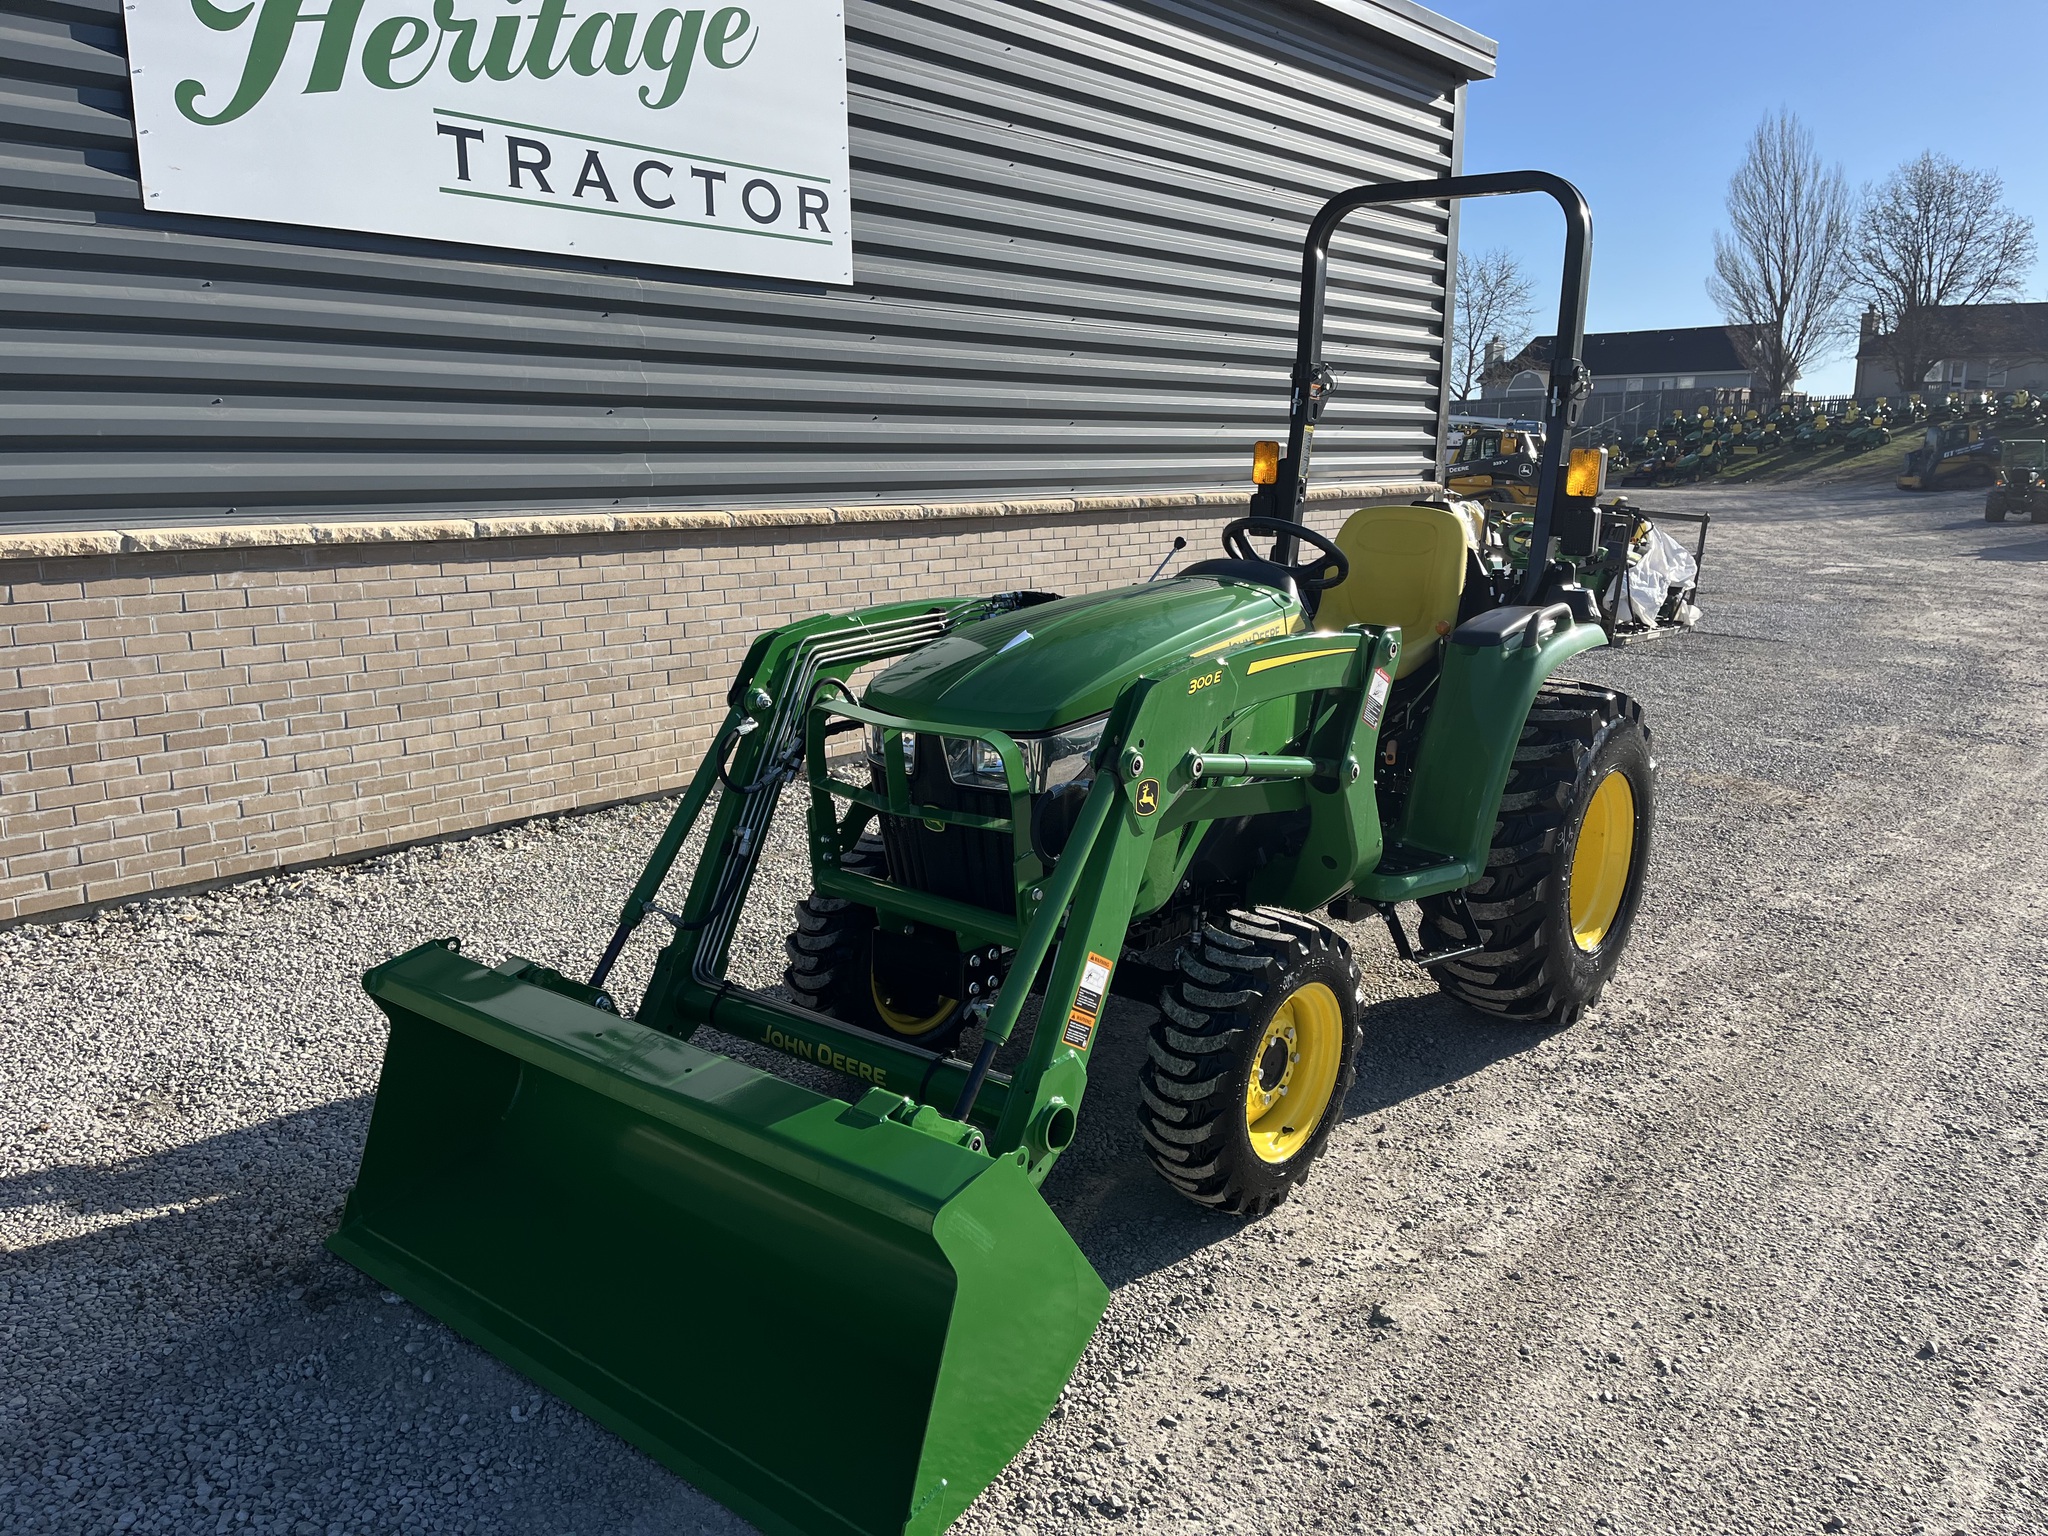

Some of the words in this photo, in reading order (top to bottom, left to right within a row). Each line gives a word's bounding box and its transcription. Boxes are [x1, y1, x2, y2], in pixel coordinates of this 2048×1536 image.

[173, 0, 760, 127] Heritage
[436, 121, 832, 234] TRACTOR
[1449, 465, 1470, 473] DEERE
[760, 1024, 813, 1060] JOHN
[817, 1043, 887, 1087] DEERE
